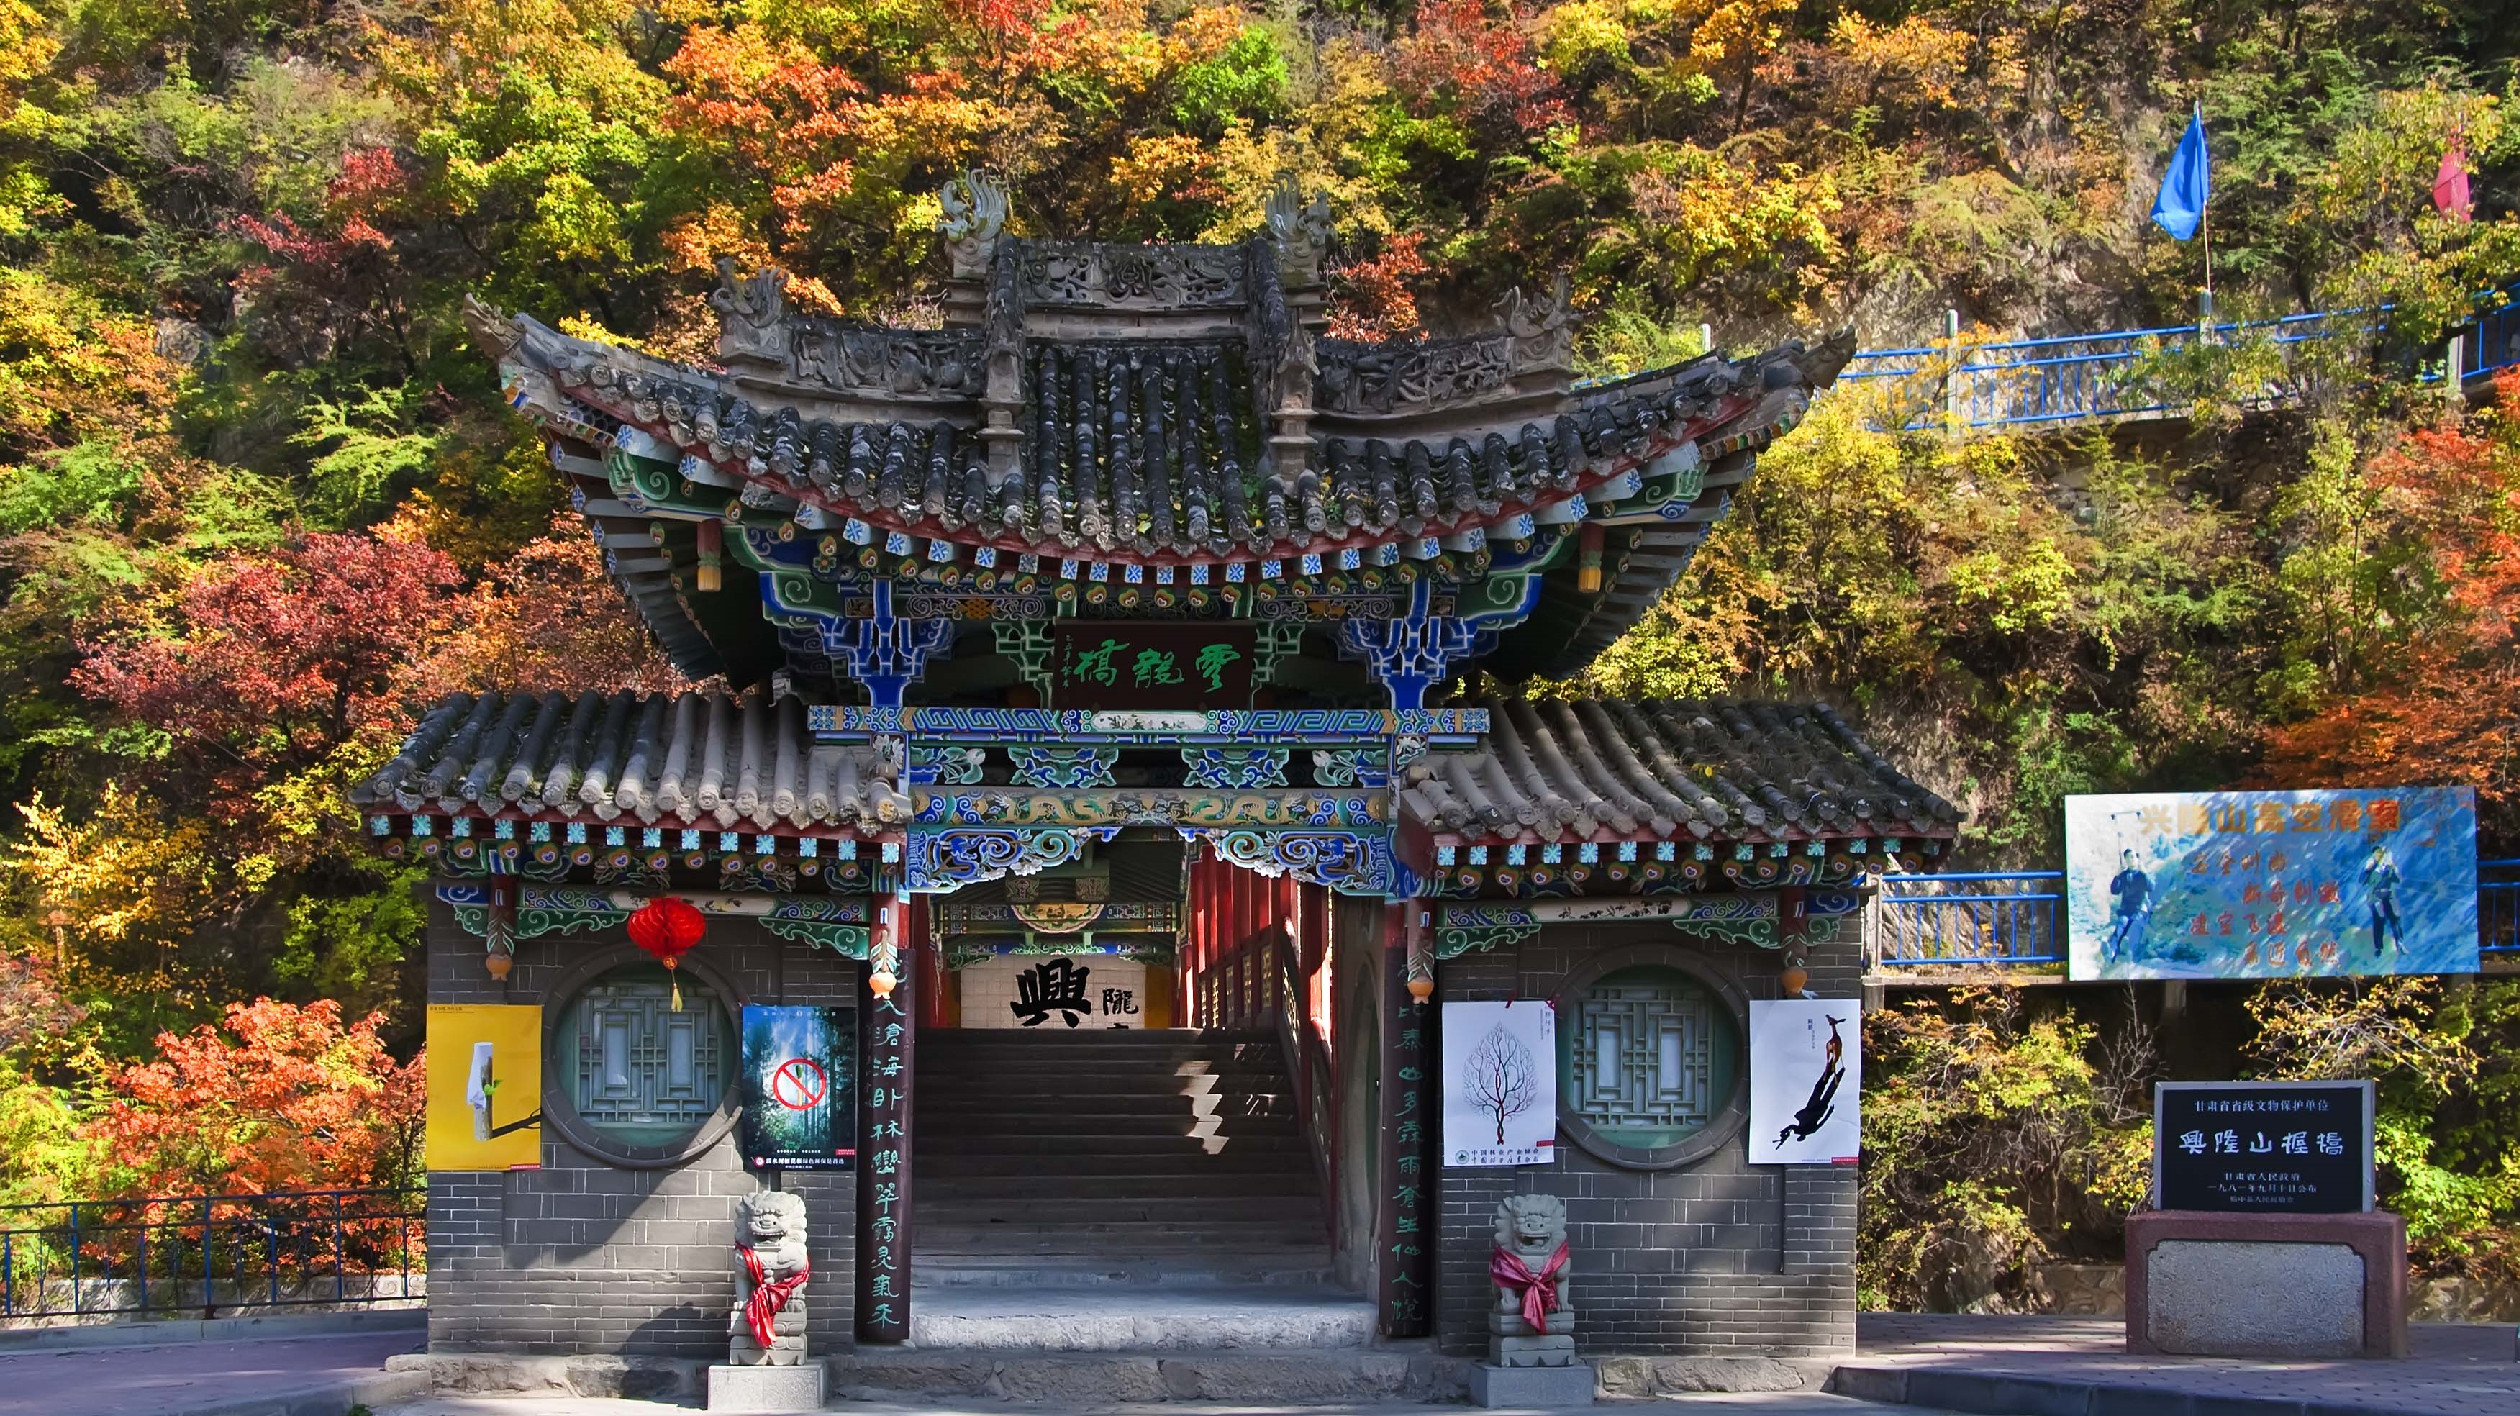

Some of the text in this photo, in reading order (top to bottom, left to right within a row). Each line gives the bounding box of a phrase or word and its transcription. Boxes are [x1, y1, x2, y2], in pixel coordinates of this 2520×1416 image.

[2140, 798, 2400, 835] 兴隆山高空滑索
[1010, 957, 1091, 1028] 興
[1102, 988, 1139, 1029] 隴
[2195, 1099, 2330, 1112] 甘肃省省级文物保护单位
[2225, 1172, 2300, 1182] 甘肃省人民政府
